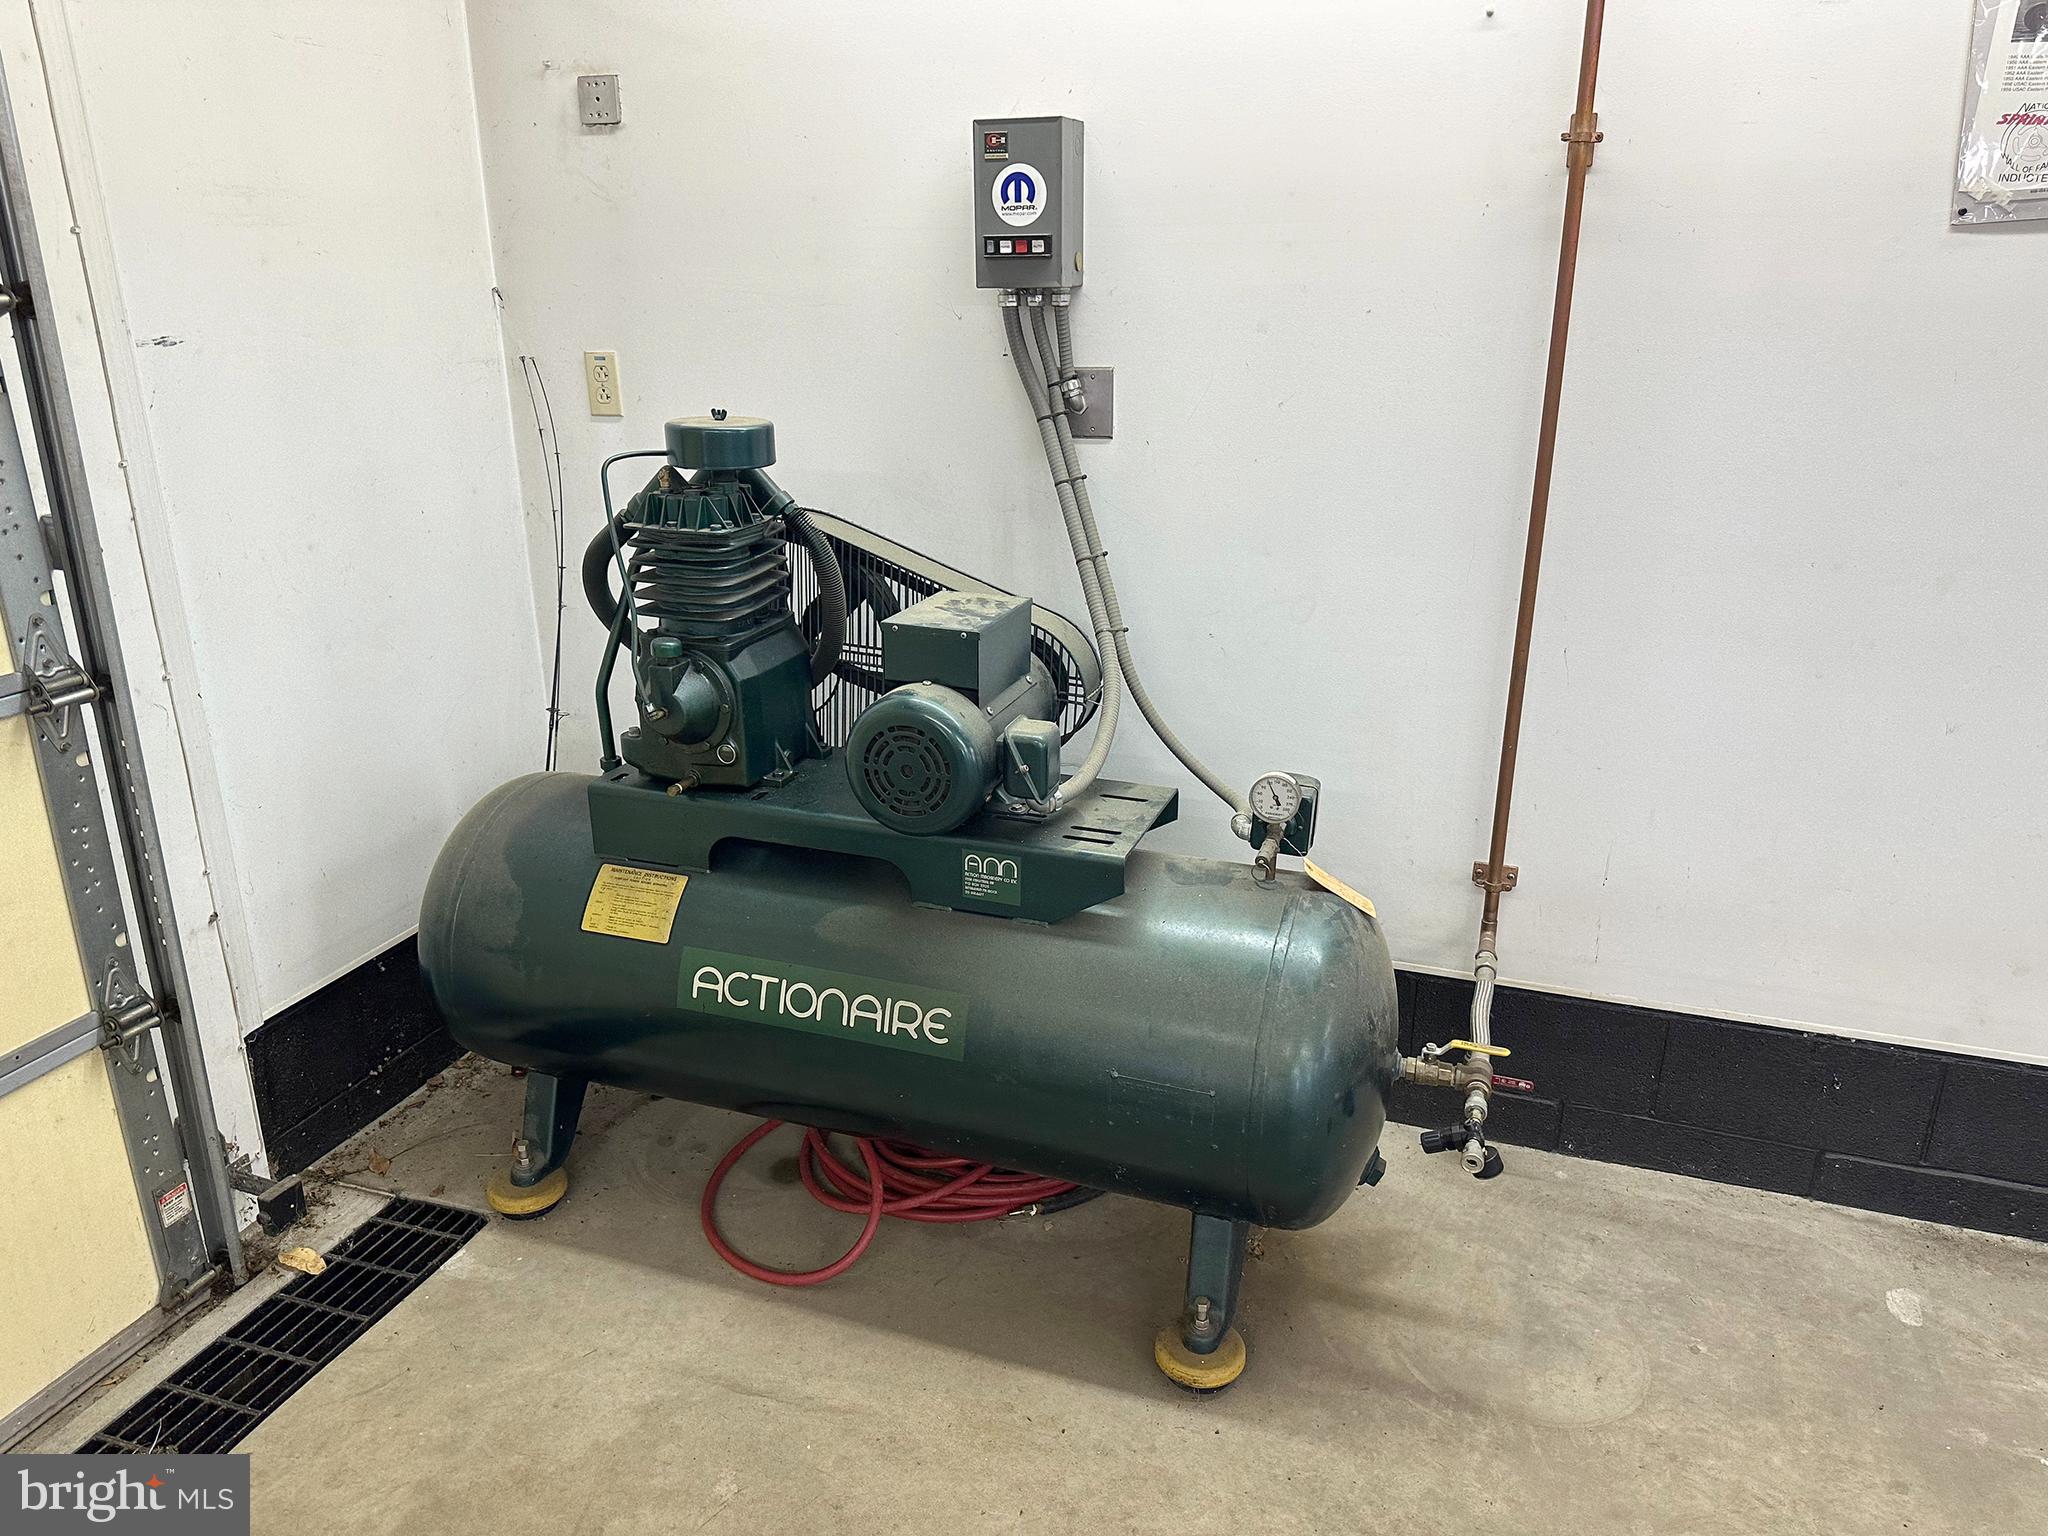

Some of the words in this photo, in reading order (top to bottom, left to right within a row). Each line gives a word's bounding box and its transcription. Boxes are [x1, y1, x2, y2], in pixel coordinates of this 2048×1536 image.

[2022, 165, 2033, 173] OF
[2035, 162, 2048, 172] FA
[692, 966, 952, 1045] ACTIONAIRE
